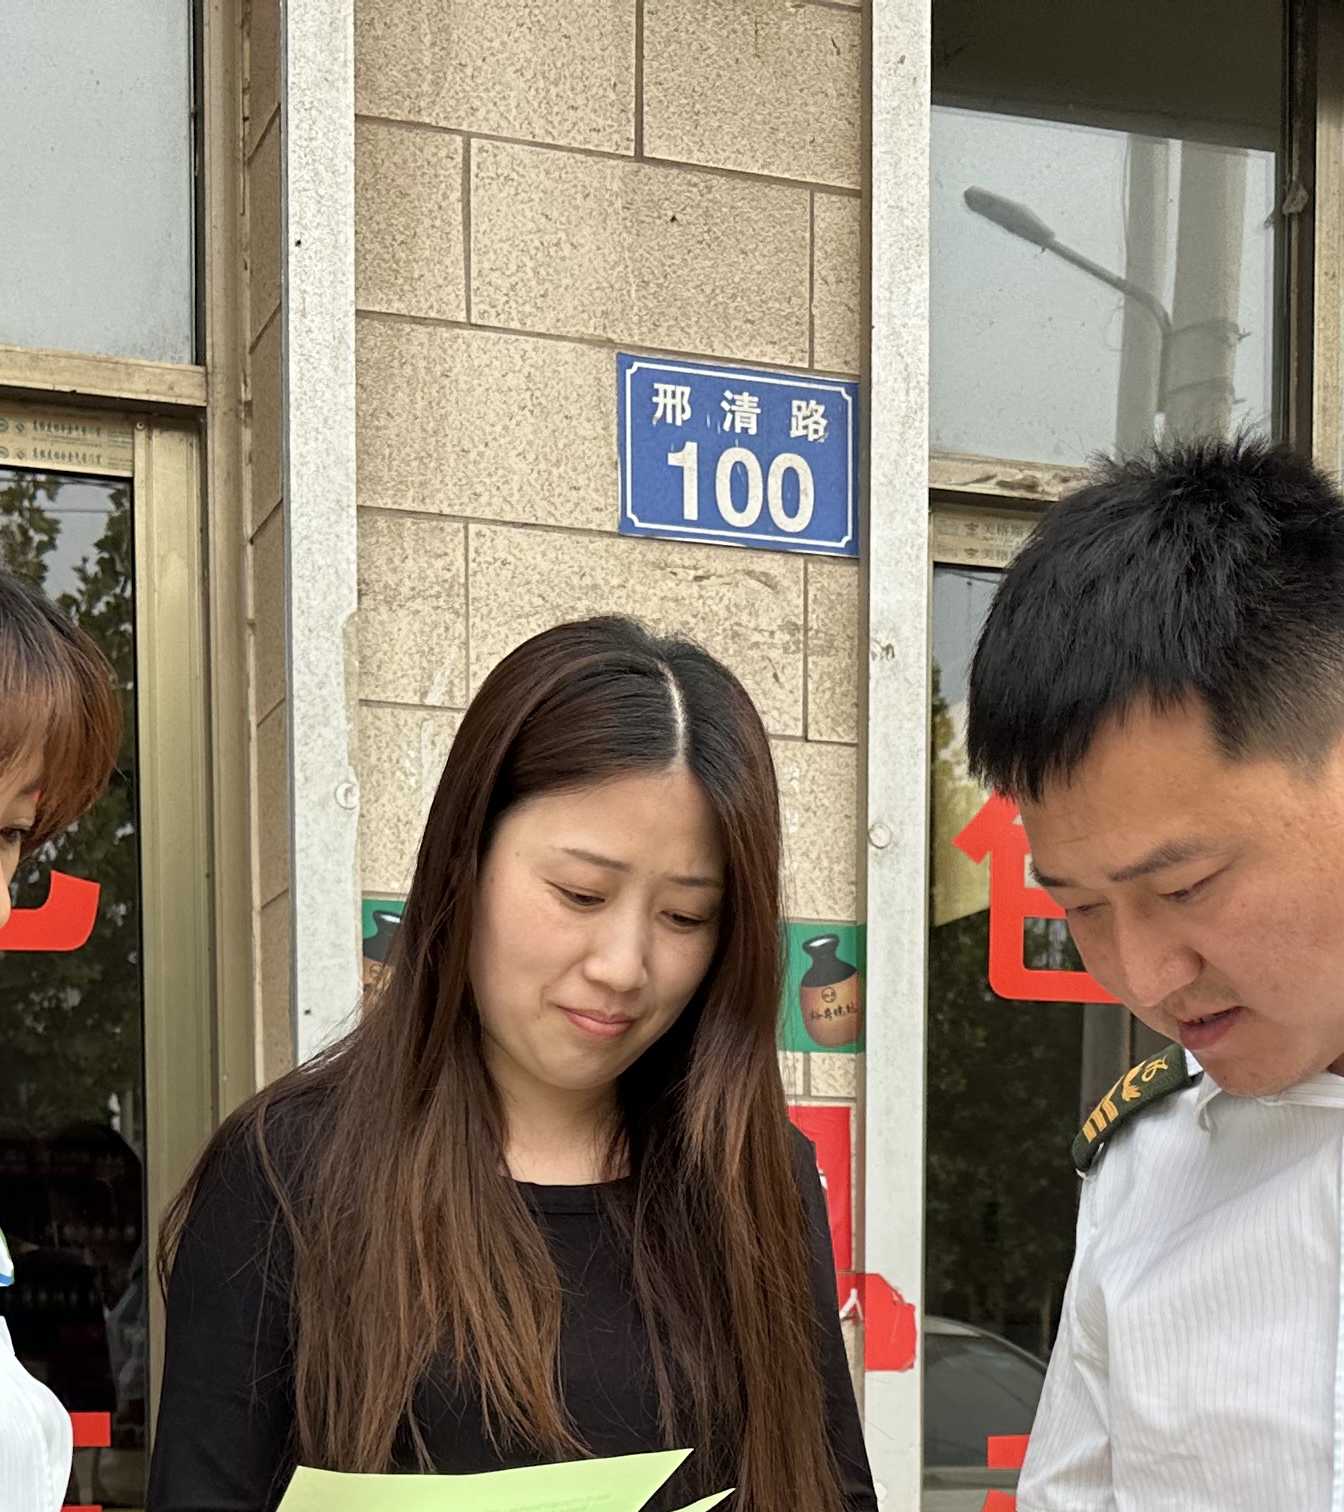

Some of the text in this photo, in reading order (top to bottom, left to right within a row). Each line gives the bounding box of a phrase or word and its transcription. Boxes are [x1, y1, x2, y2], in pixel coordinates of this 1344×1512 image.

[652, 383, 829, 443] 邢清路
[667, 441, 815, 533] 100
